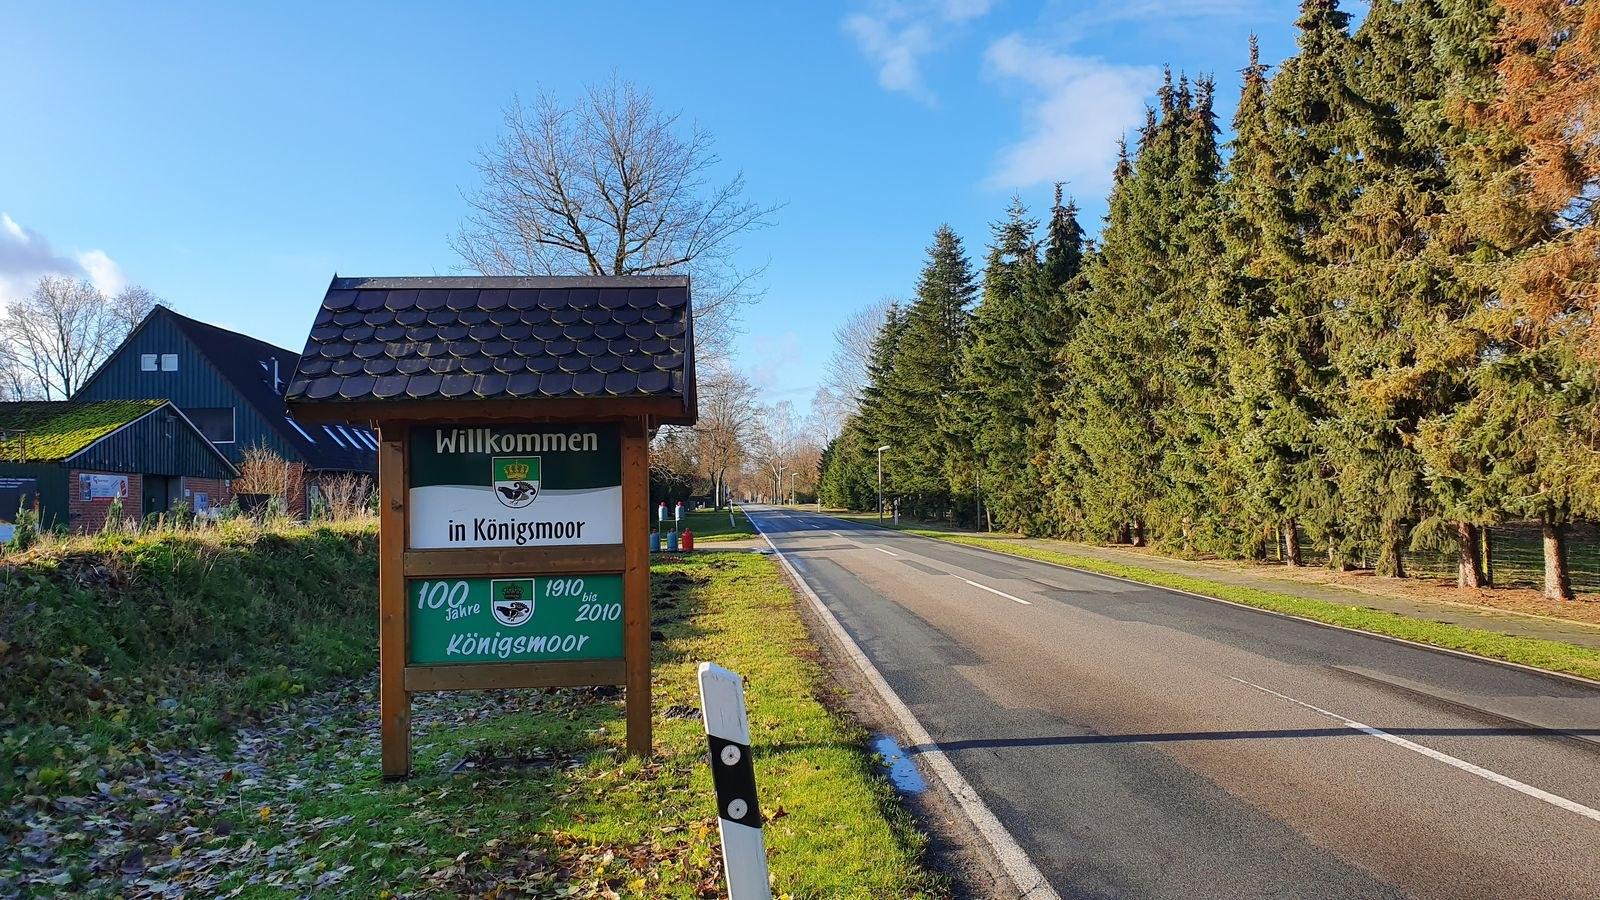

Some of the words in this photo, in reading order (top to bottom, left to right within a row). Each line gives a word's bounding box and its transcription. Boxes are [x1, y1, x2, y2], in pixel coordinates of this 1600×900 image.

[436, 428, 598, 454] Willkommen
[449, 520, 466, 541] in
[474, 518, 585, 545] Königsmoor
[417, 580, 469, 610] 100
[545, 579, 584, 597] 1910
[582, 592, 598, 602] bis
[575, 603, 622, 622] 2010
[446, 632, 590, 659] Königsmoor
